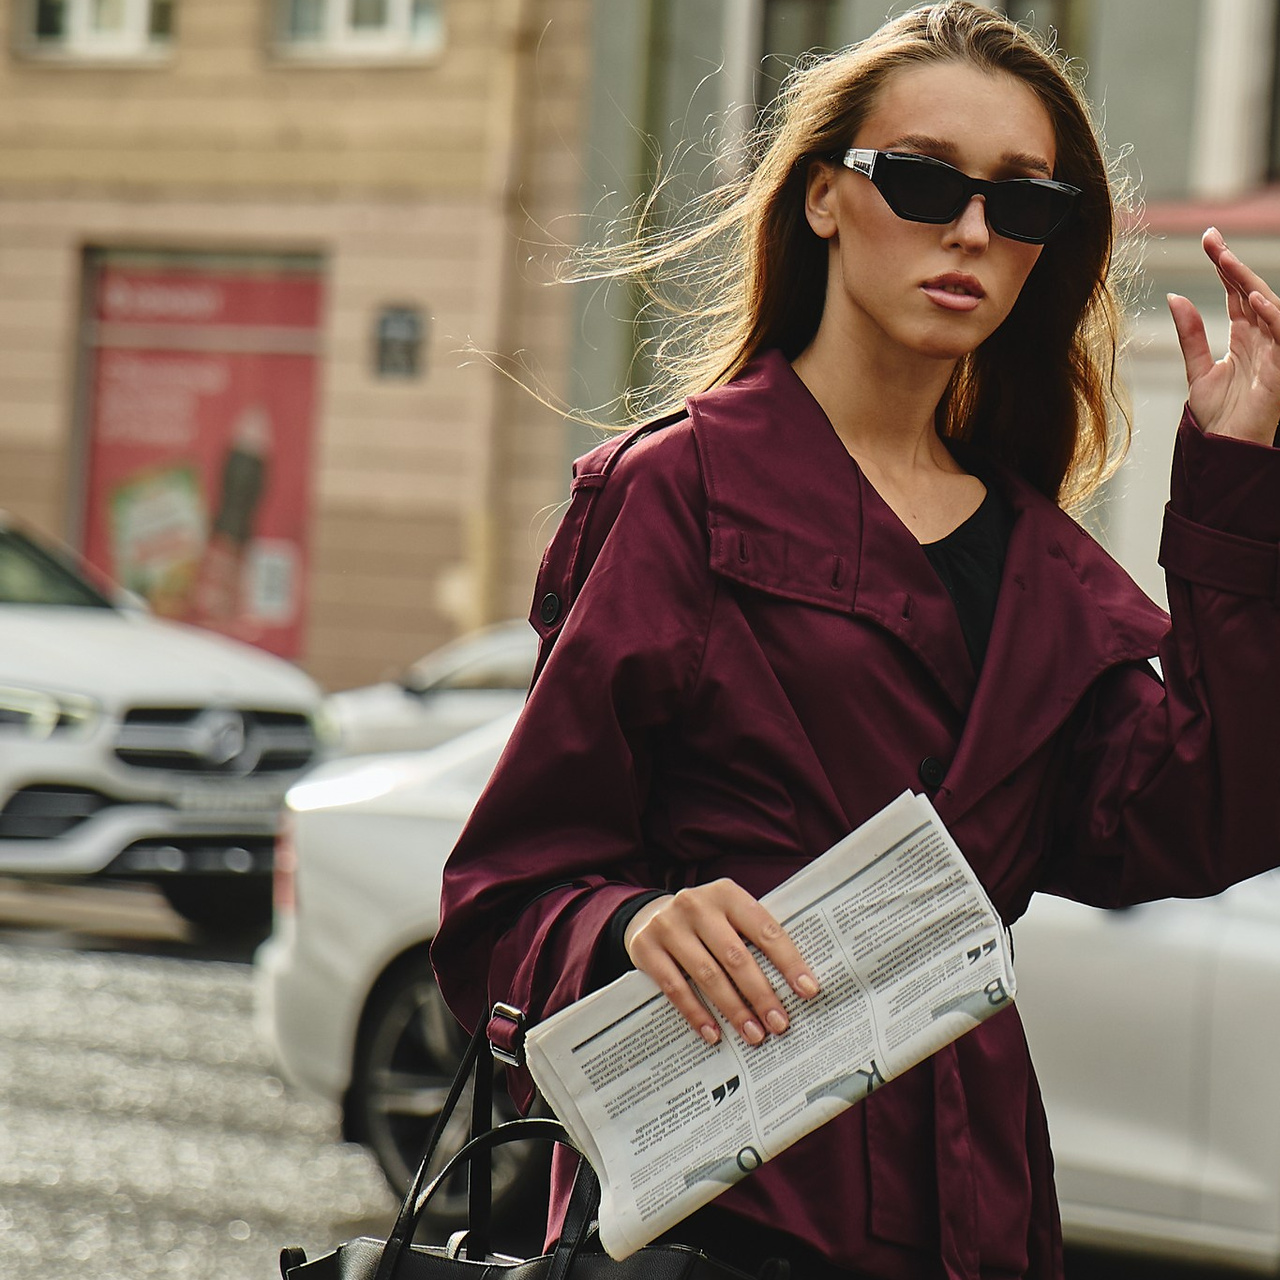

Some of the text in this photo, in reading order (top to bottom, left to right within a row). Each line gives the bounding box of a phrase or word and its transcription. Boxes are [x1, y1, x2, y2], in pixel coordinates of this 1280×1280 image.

[664, 1085, 695, 1105] случится.
[678, 1093, 709, 1114] выбирать
[658, 1096, 691, 1119] совпадение
[690, 1104, 712, 1120] Логика
[634, 1116, 659, 1134] никогда
[667, 1109, 693, 1127] простая.
